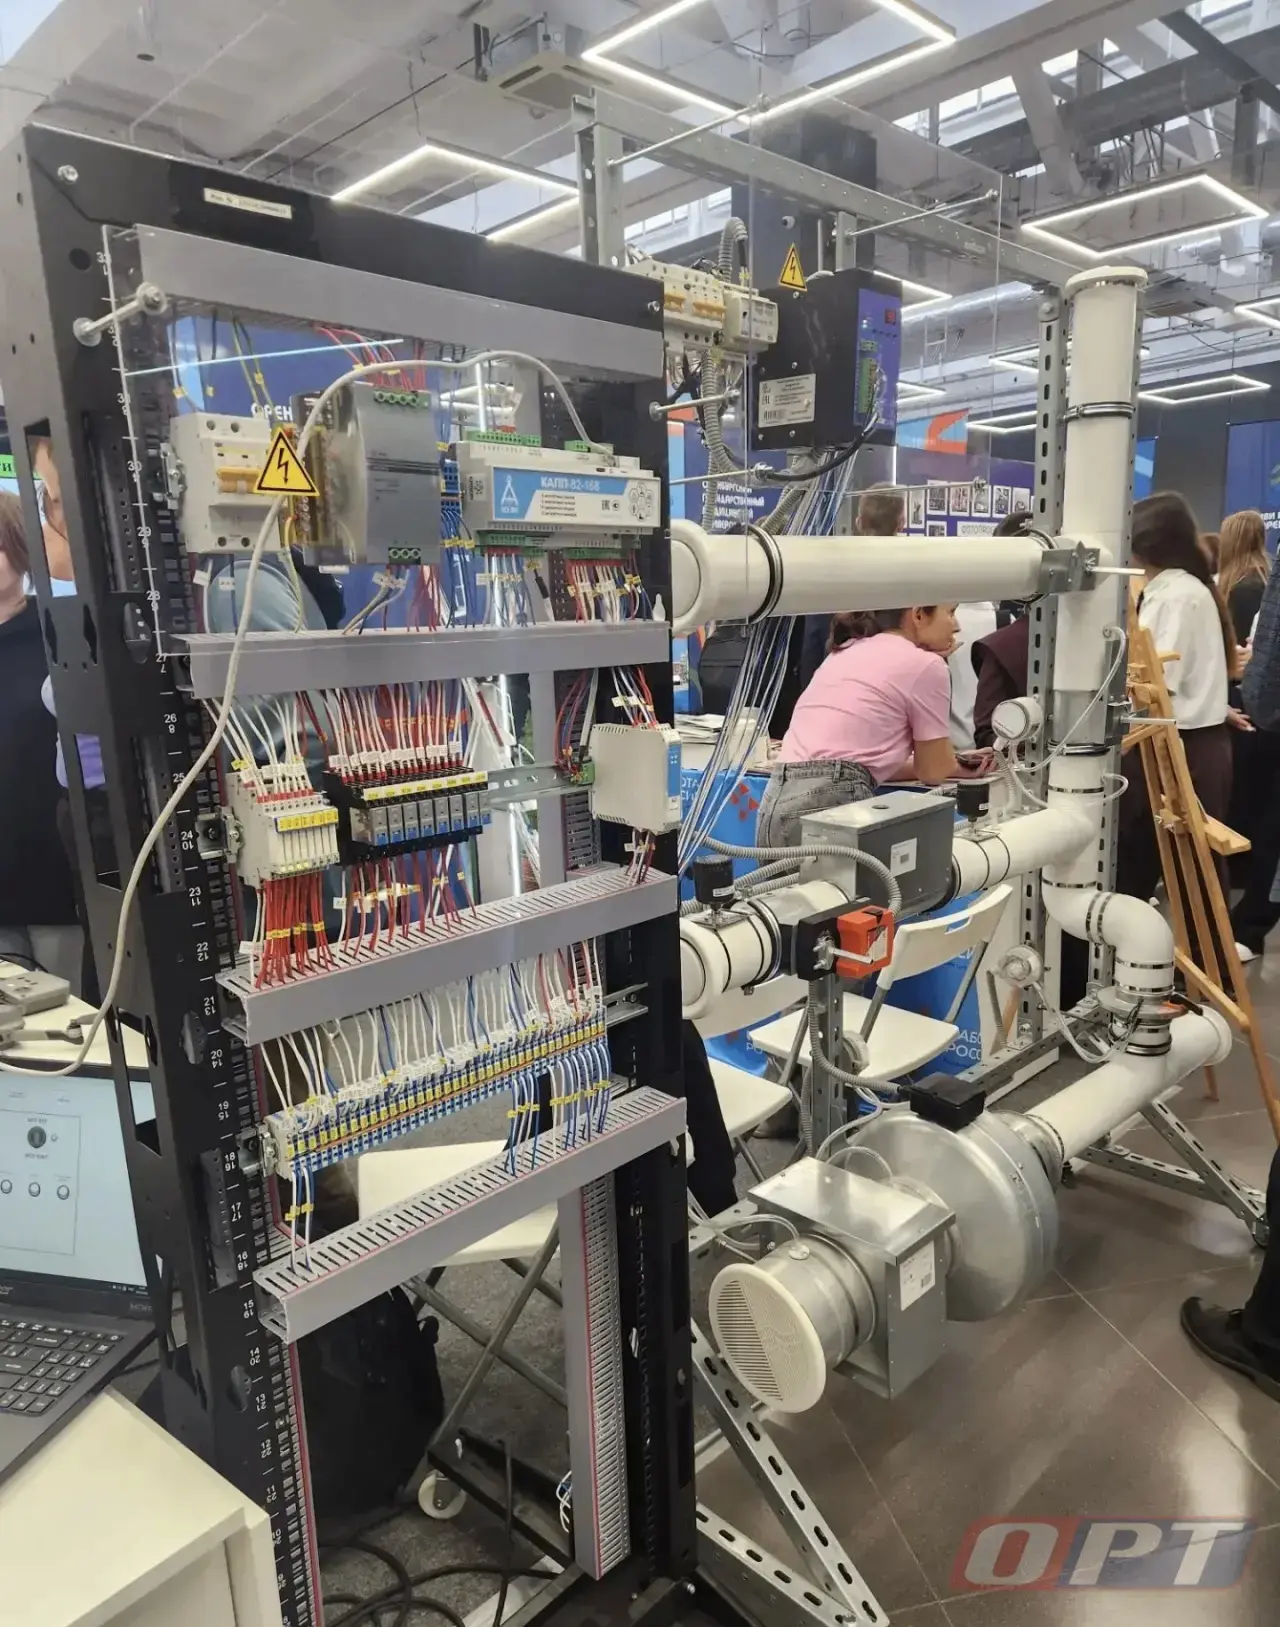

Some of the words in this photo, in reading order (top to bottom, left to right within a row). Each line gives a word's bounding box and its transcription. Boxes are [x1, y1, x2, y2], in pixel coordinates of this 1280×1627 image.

[702, 493, 765, 507] ГУДАРСТВЕННЫЙ
[164, 714, 177, 723] 26
[173, 773, 185, 782] 25
[181, 831, 193, 840] 24
[189, 887, 201, 897] 23
[192, 897, 201, 906] 11
[197, 942, 208, 952] 22
[204, 996, 214, 1006] 21
[211, 1049, 222, 1059] 20
[218, 1101, 229, 1110] 19
[225, 1152, 235, 1162] 18
[231, 1202, 242, 1211] 17
[244, 1300, 254, 1310] 15
[250, 1347, 260, 1357] 14
[256, 1394, 266, 1403] 13
[261, 1439, 271, 1449] 12
